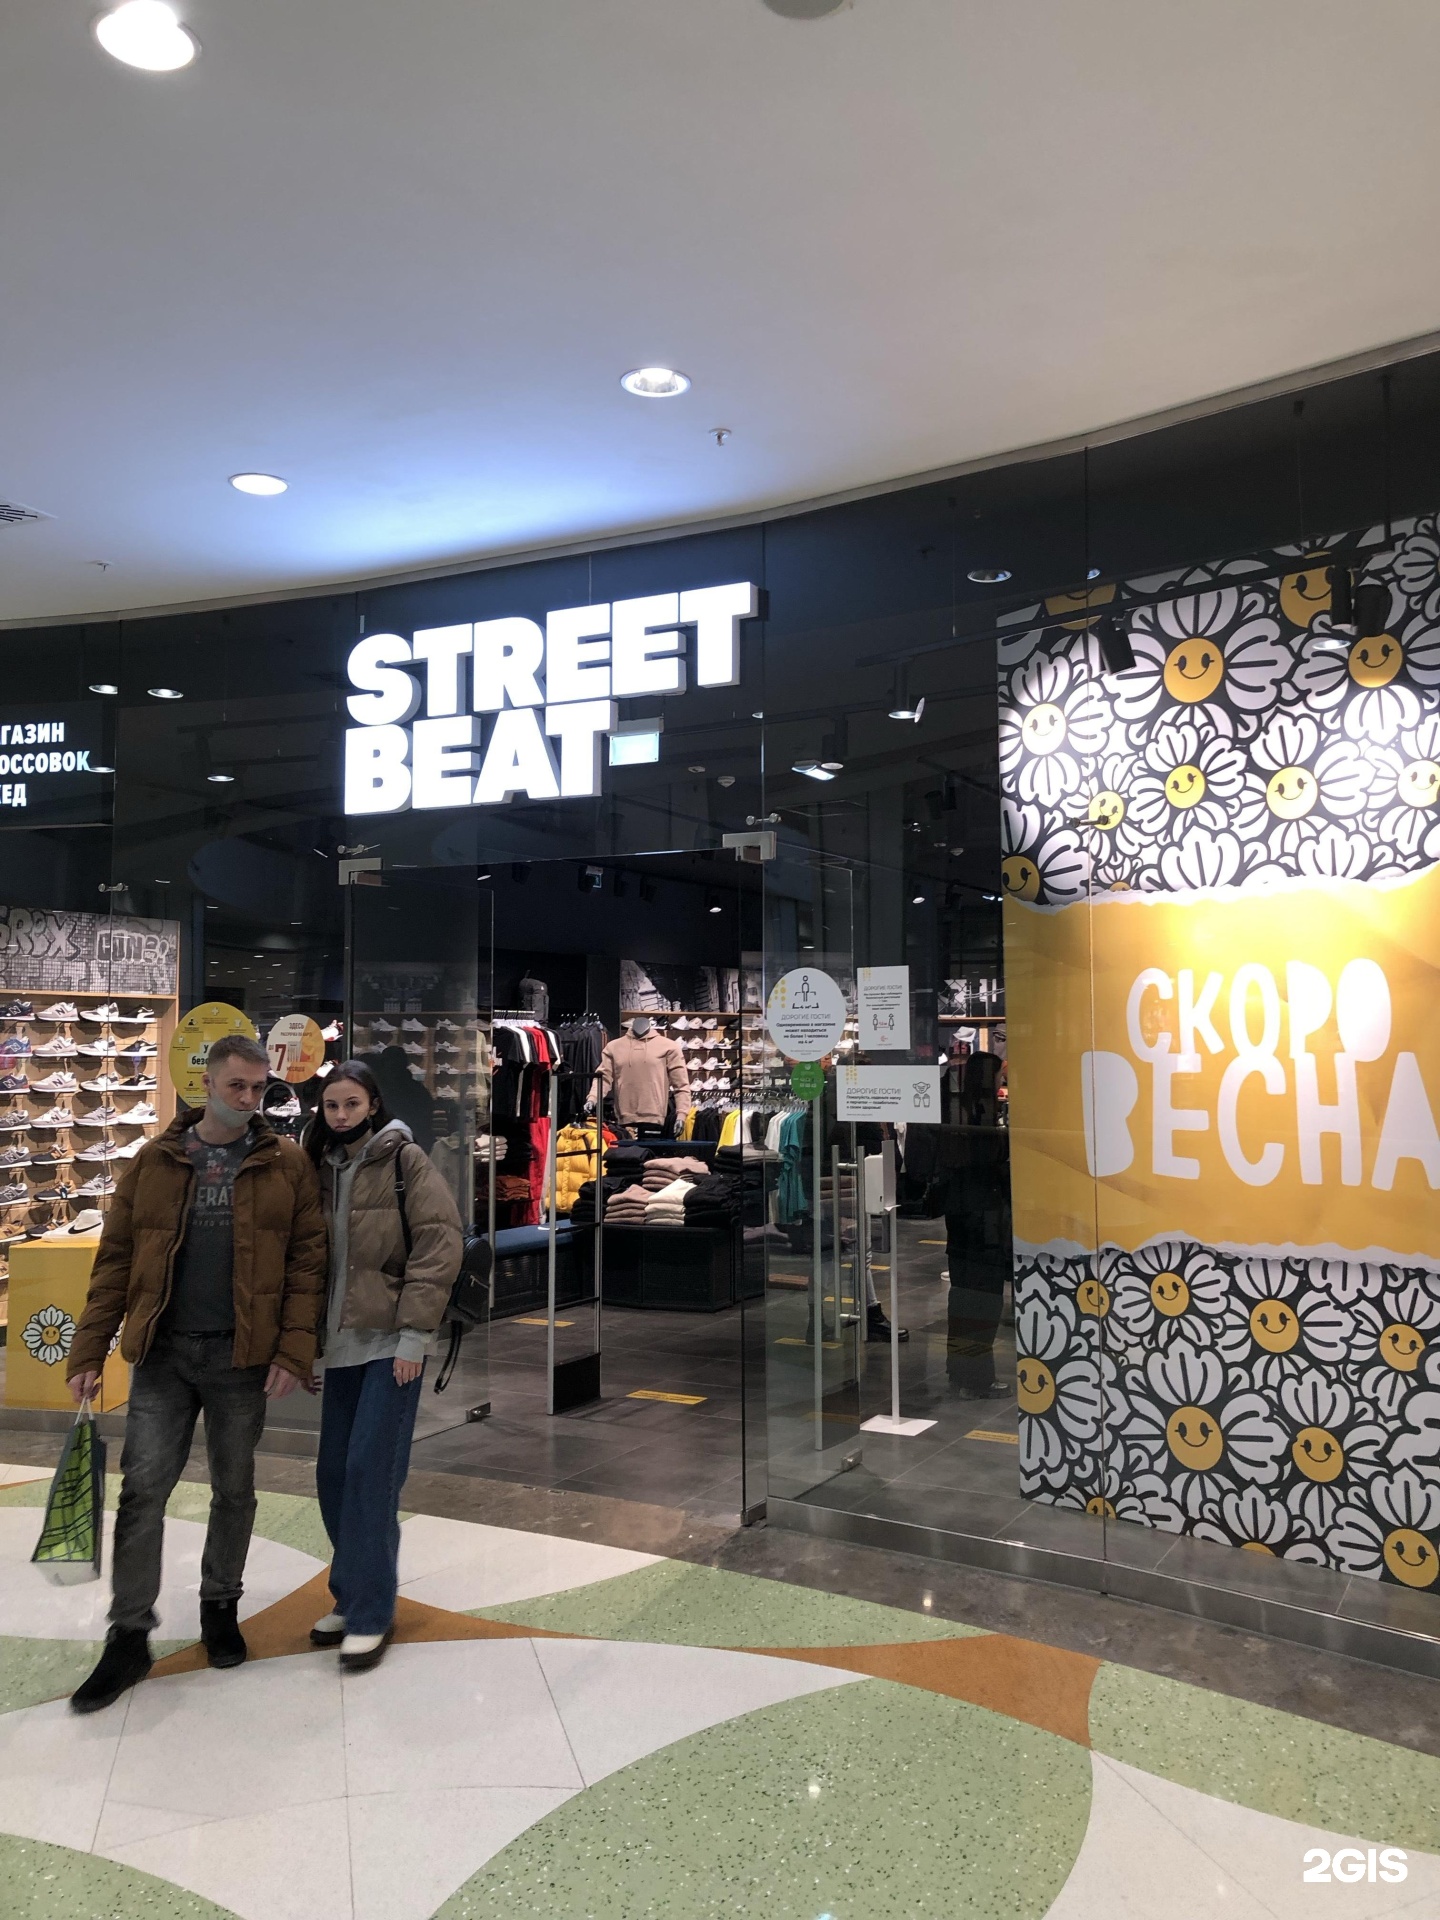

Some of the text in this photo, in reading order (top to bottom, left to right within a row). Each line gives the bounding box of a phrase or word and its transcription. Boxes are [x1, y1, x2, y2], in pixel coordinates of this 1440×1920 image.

[346, 581, 758, 726] STREET
[0, 722, 65, 746] ГАЗИН
[344, 699, 619, 815] BEAT
[0, 783, 27, 808] ЕД
[275, 1044, 286, 1071] 7
[1126, 957, 1392, 1063] СКОРО
[1081, 1050, 1440, 1191] ВЕСНА
